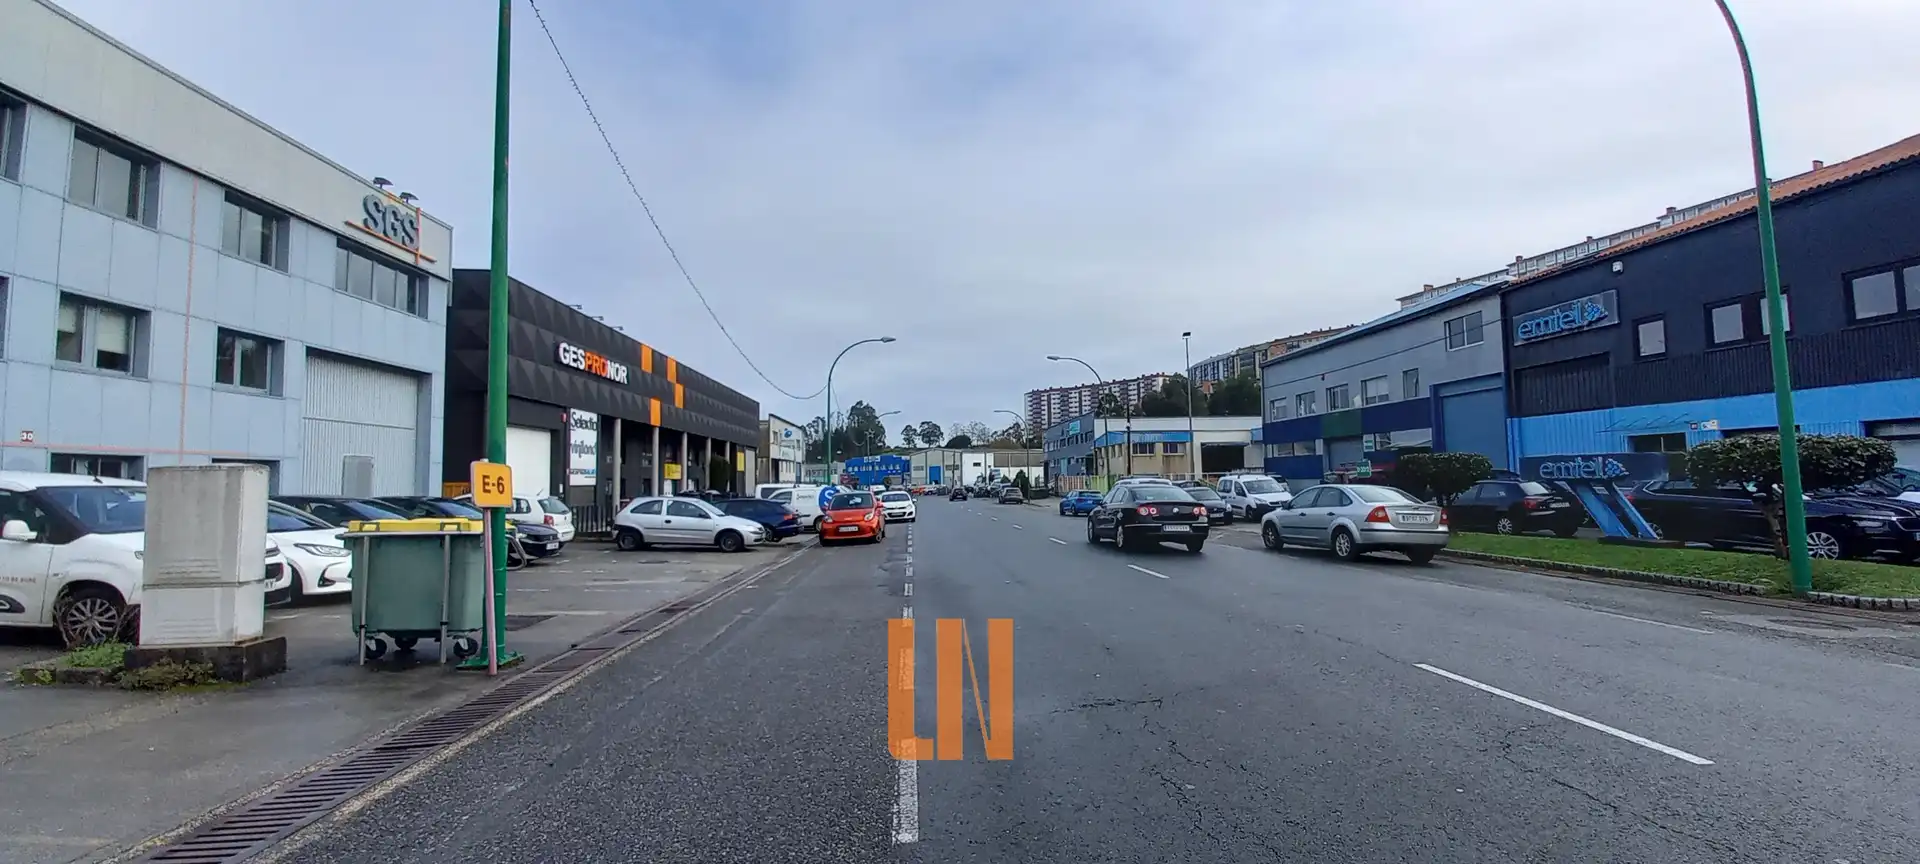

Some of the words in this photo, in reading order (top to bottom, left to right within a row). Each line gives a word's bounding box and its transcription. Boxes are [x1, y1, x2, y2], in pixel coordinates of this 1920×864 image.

[363, 195, 419, 250] SGS
[559, 342, 628, 385] GESPRONOR
[22, 432, 33, 441] 30
[482, 475, 505, 495] E-6
